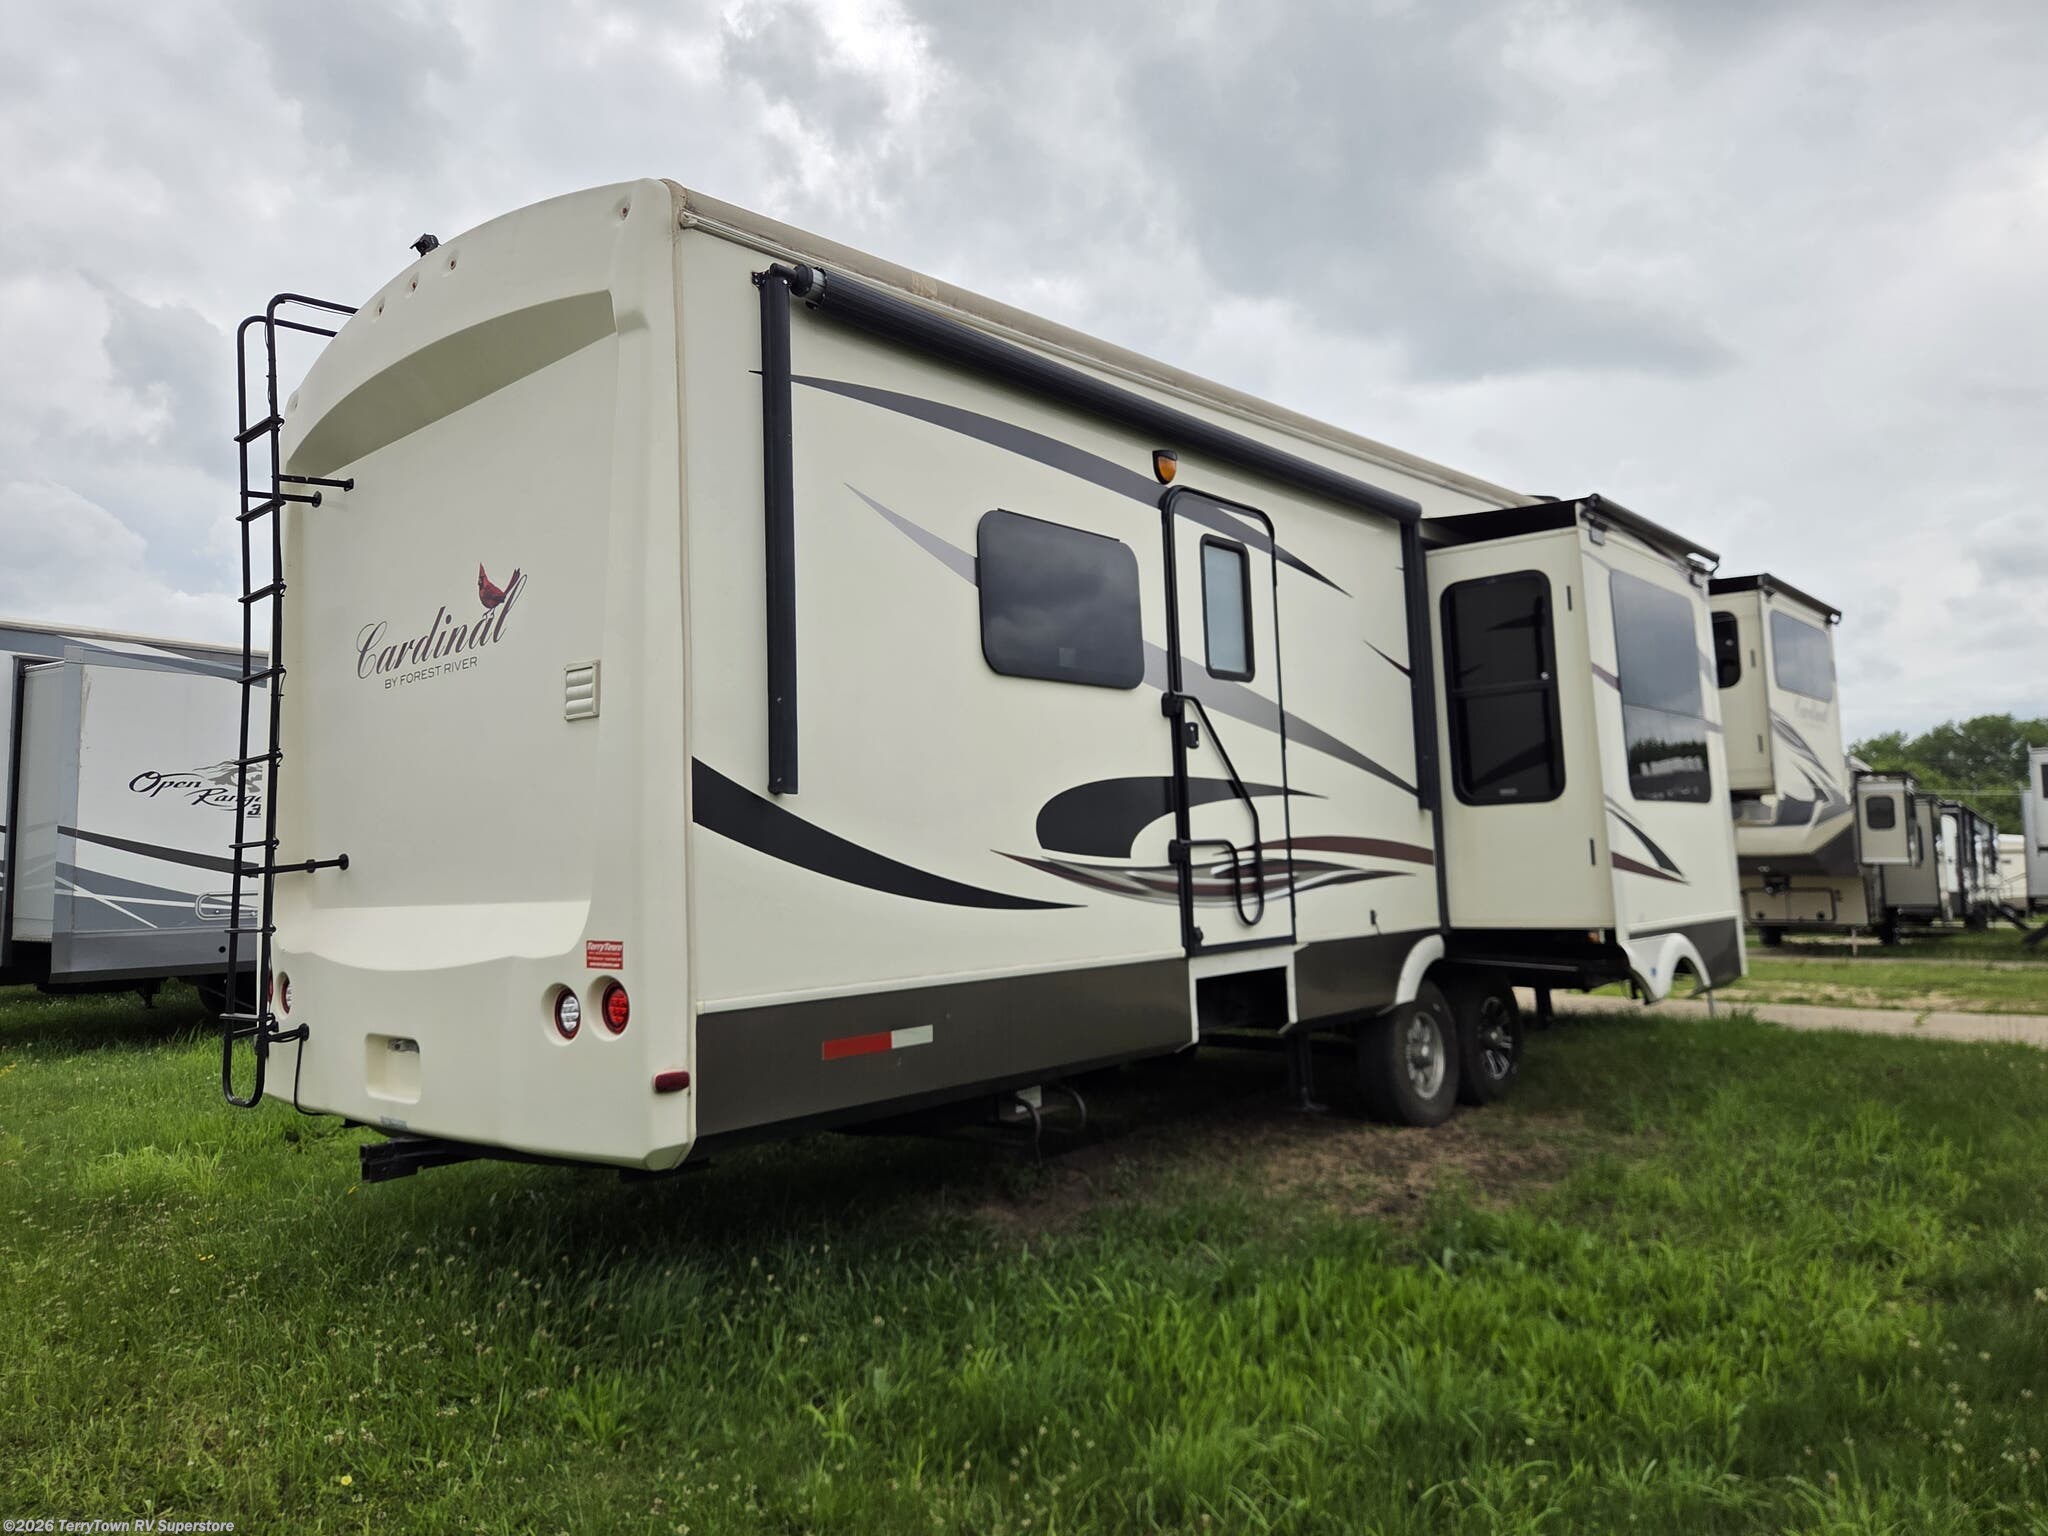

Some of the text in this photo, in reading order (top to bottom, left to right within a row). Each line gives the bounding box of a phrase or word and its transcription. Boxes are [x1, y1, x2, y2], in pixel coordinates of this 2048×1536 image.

[356, 573, 528, 680] Cardinal
[384, 656, 478, 689] BY FOREST RIVER
[129, 771, 204, 798] Open
